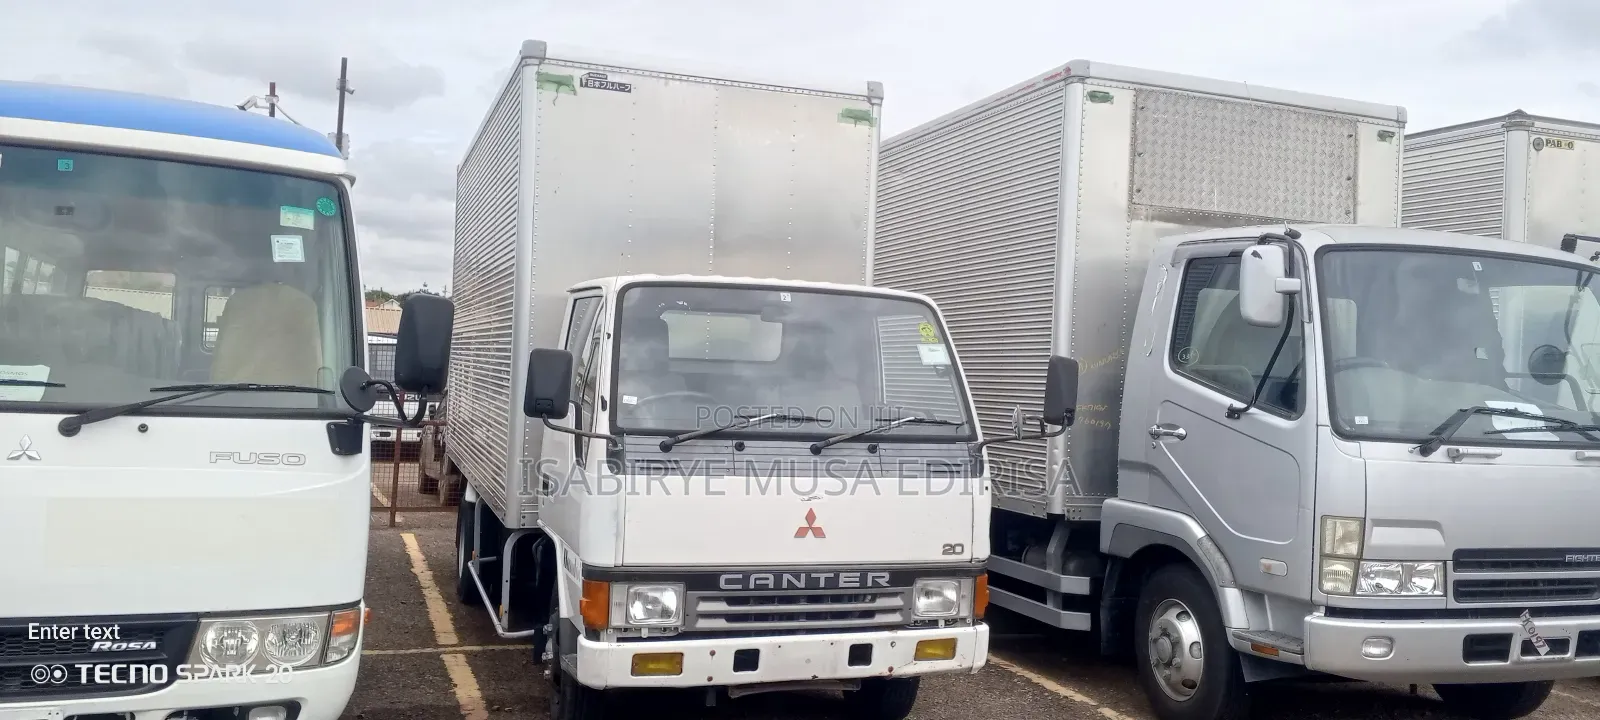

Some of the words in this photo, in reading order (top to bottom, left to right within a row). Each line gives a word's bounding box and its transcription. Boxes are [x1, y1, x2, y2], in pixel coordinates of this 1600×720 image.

[587, 80, 631, 92] 日本フルハーフ
[1546, 139, 1574, 149] PABO
[209, 451, 306, 466] FUSO
[942, 543, 964, 555] 20
[719, 571, 891, 590] CANTER
